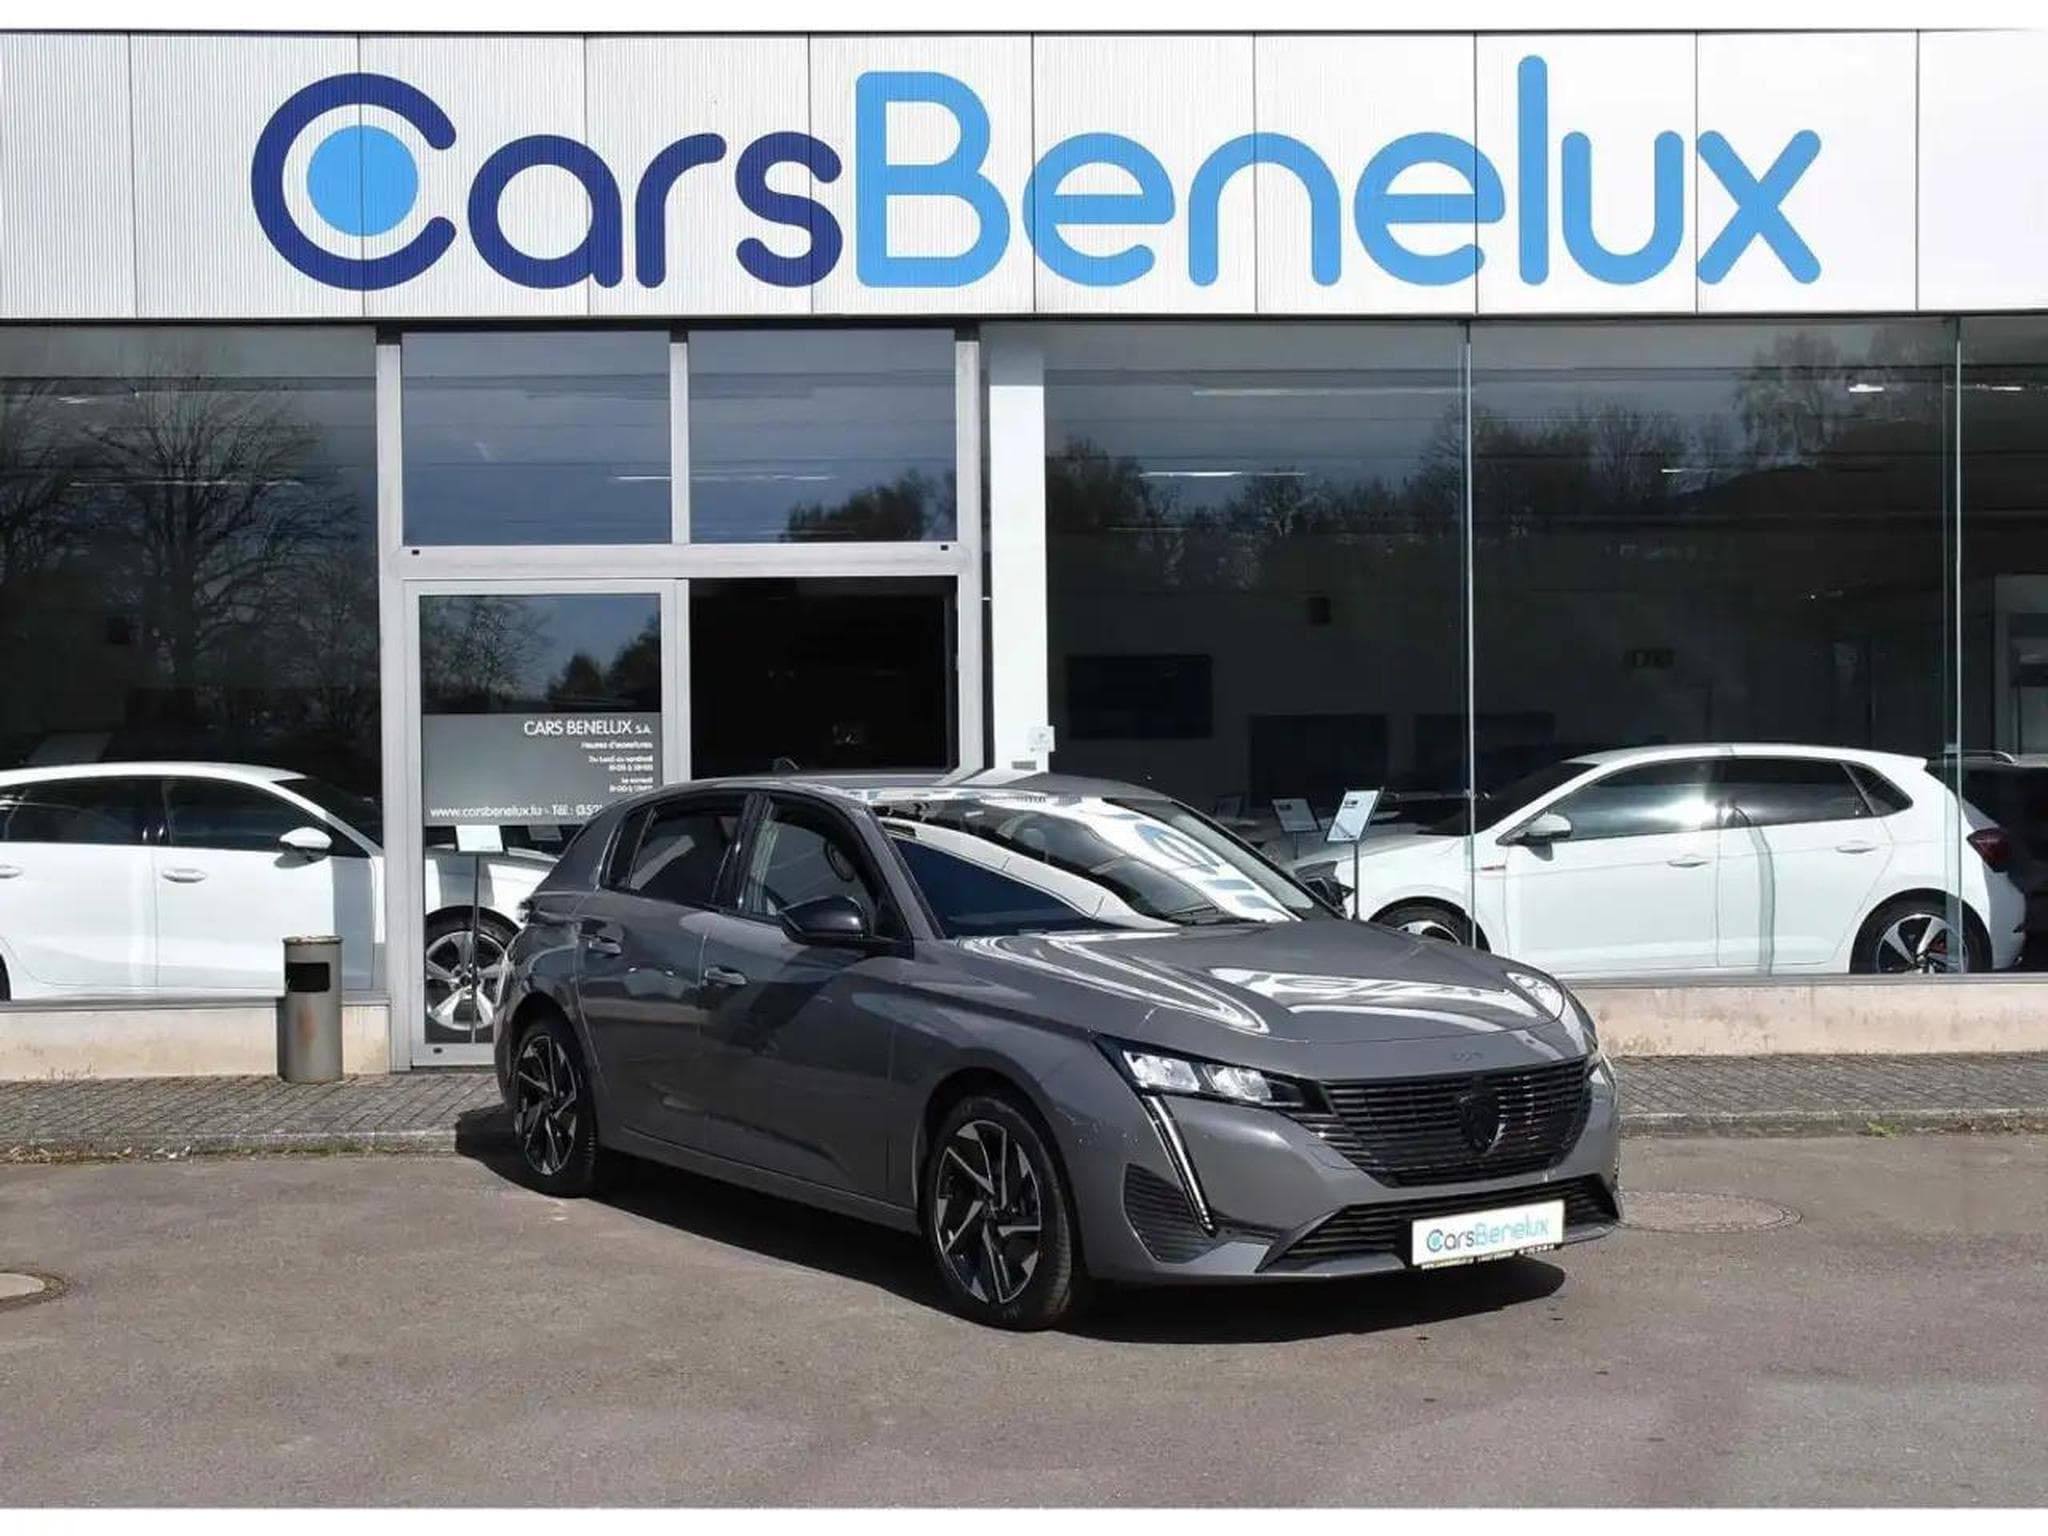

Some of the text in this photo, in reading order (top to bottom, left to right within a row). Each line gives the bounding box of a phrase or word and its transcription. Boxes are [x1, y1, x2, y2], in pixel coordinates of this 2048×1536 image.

[252, 56, 1821, 288] CarsBenelux
[523, 719, 563, 736] CARS
[566, 719, 632, 735] BENELUX
[1426, 1213, 1549, 1253] CarsBenelux
